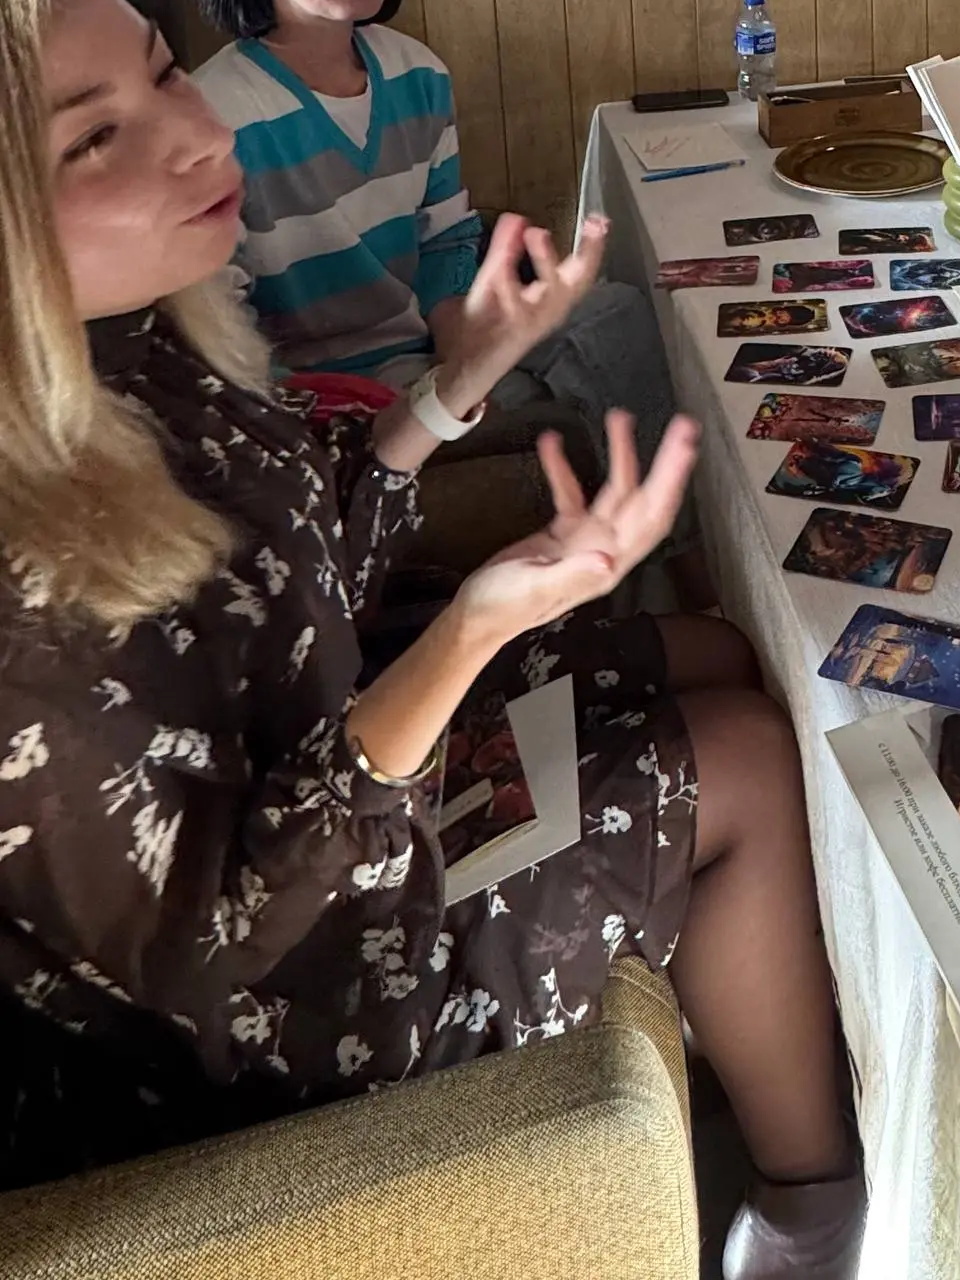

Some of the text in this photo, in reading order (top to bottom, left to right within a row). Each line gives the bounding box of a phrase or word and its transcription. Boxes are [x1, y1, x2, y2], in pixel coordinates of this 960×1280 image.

[893, 799, 918, 837] Игристое
[914, 837, 927, 856] или
[924, 854, 940, 877] кофе
[907, 794, 920, 814] при
[917, 813, 934, 841] заказе
[931, 838, 952, 872] любого
